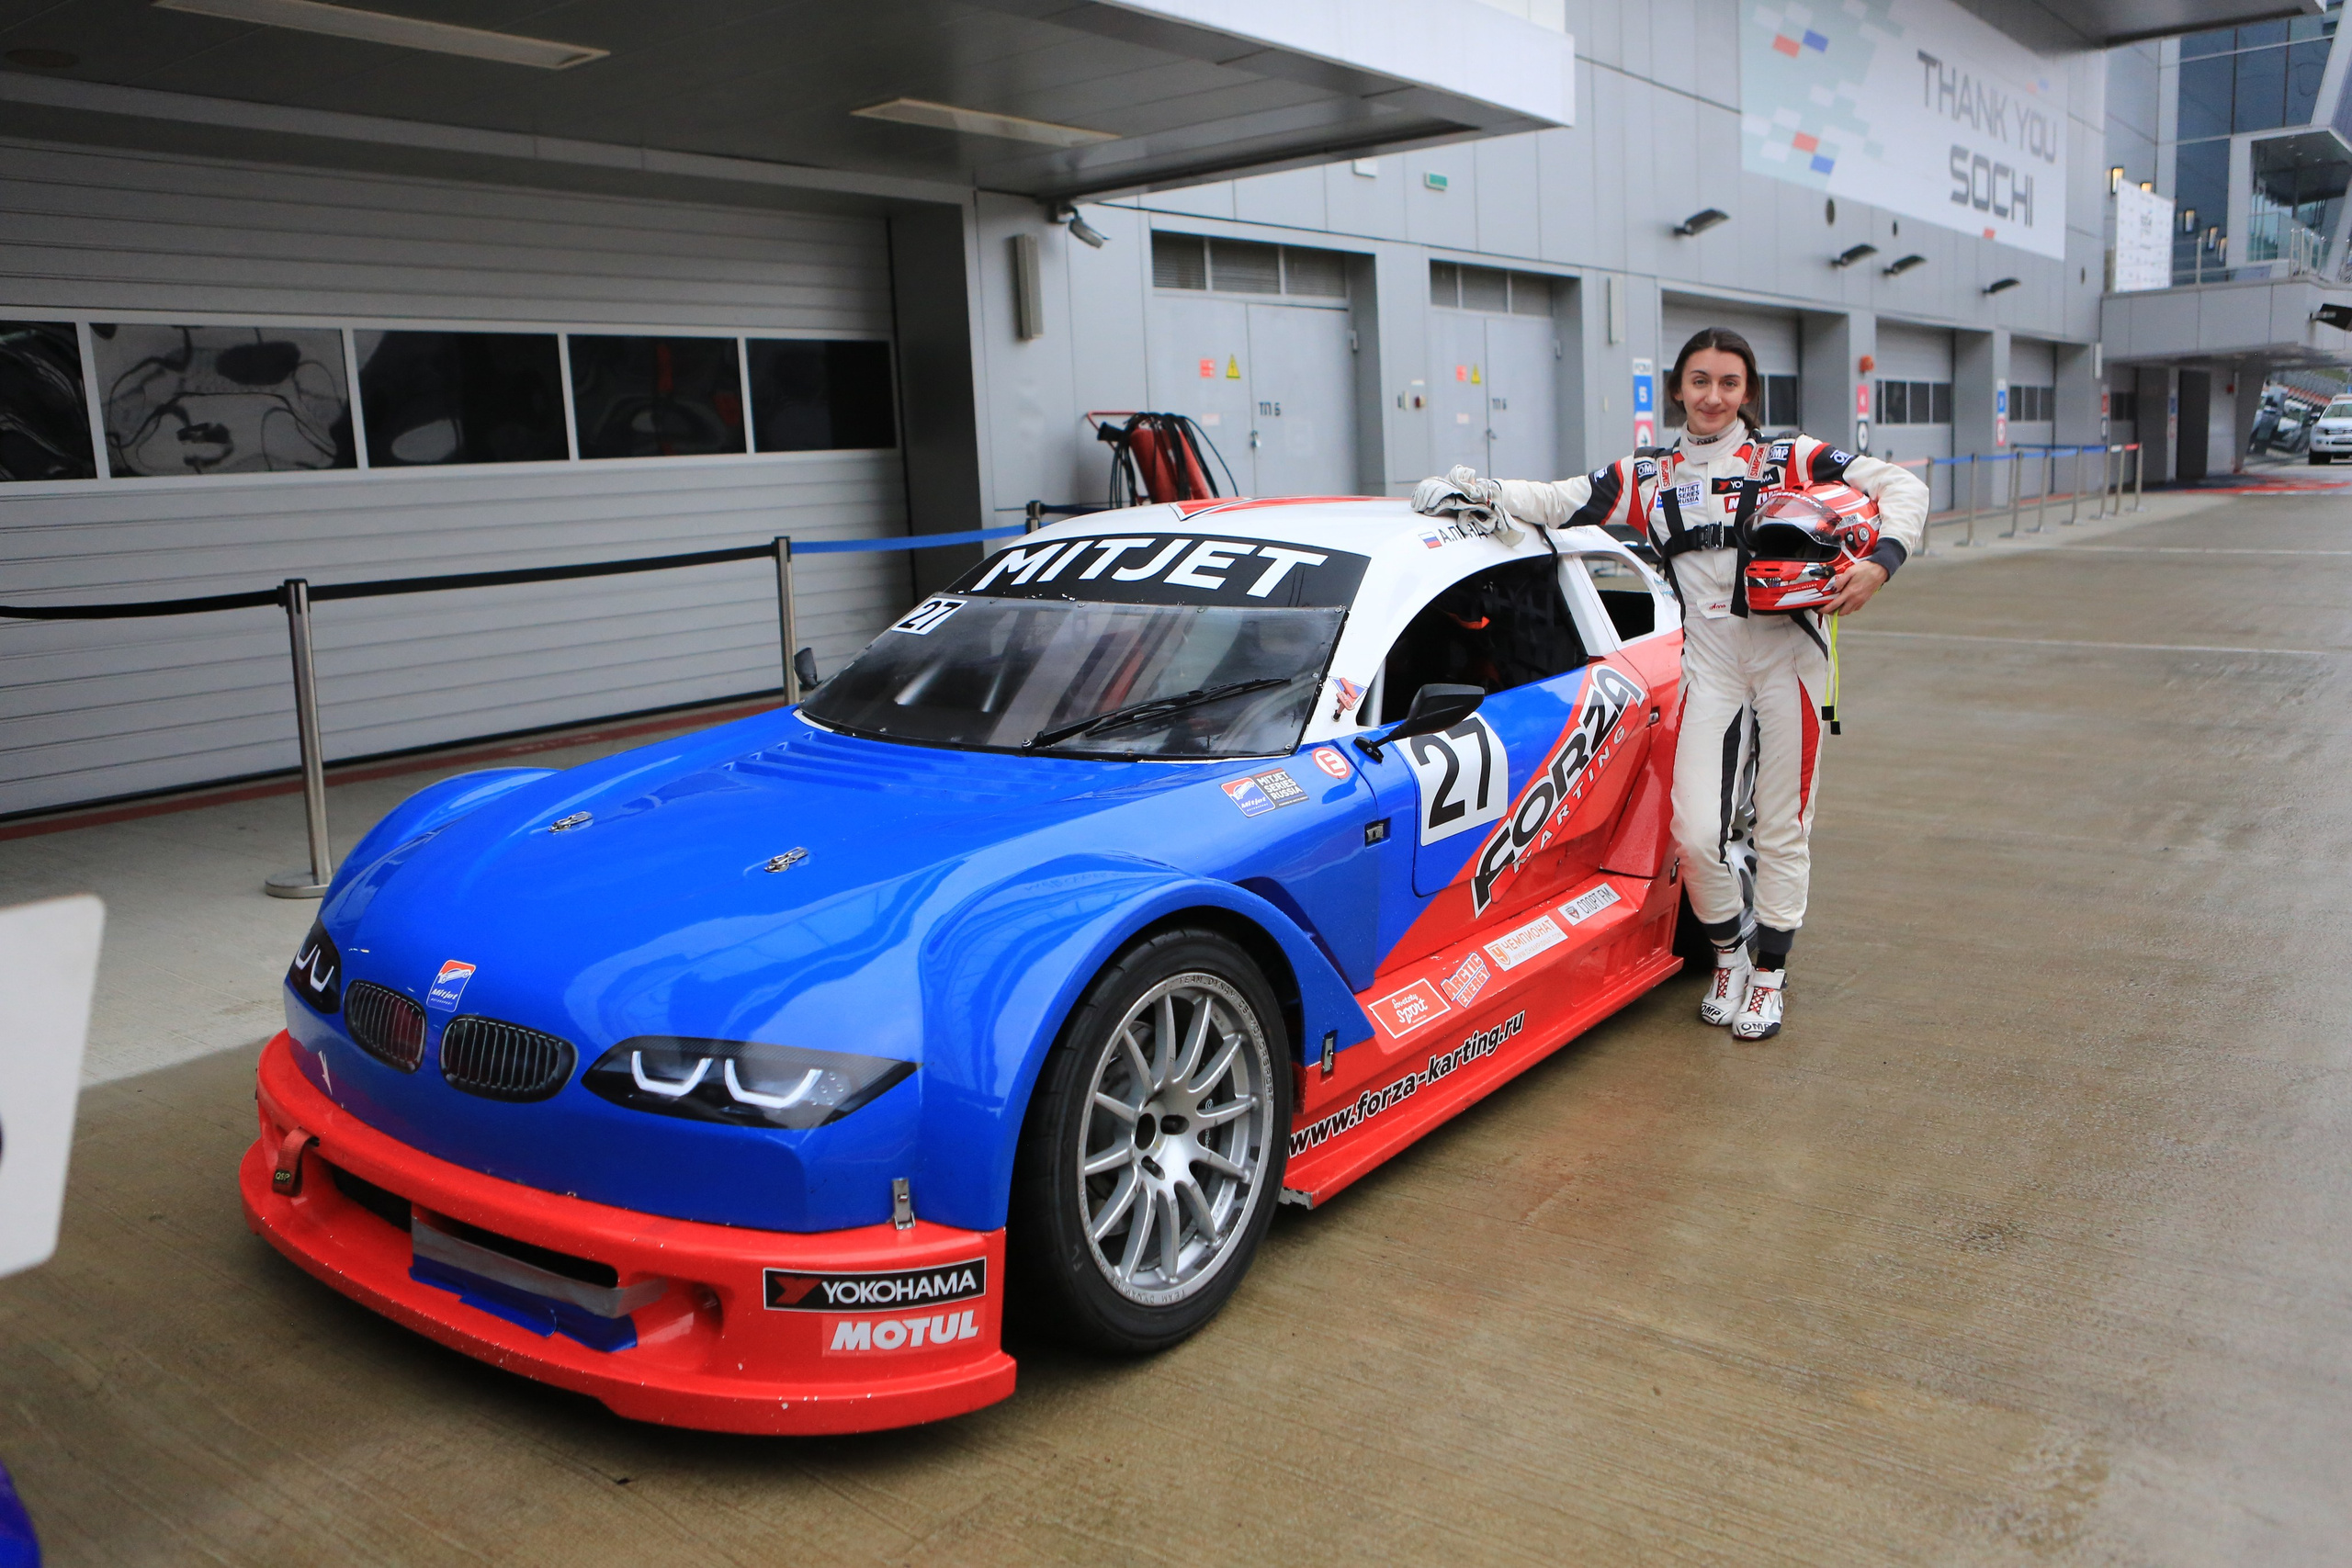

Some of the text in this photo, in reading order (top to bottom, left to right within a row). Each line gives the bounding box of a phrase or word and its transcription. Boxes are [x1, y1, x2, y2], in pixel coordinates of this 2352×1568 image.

[1917, 48, 2058, 164] THANK YOU
[1950, 143, 2033, 228] SOCHI
[1638, 386, 1648, 403] 5
[1750, 447, 1764, 476] SIMPSON
[1678, 497, 1700, 505] RUSSIA
[1679, 485, 1700, 493] MITJET
[1679, 491, 1700, 500] SERIES
[971, 538, 1329, 599] MITJET
[909, 602, 957, 631] 27
[1318, 752, 1345, 773] E
[1410, 716, 1491, 829] 27
[1256, 772, 1289, 786] MITJET
[1263, 779, 1296, 794] SERIES
[1271, 786, 1303, 800] RUSSIA
[1474, 665, 1644, 915] FORZA
[1240, 796, 1266, 808] Mitjet
[1514, 726, 1625, 873] KARTING
[1577, 887, 1614, 915] СПОРТ FM
[1502, 919, 1555, 952] ЧЕМПИОНАТ
[1441, 953, 1484, 1001] ARCTIC
[1457, 966, 1490, 1008] ENERGY
[431, 988, 458, 999] Mitjet
[1702, 1005, 1721, 1016] OMP
[1289, 1010, 1525, 1158] www.forza-karting.ru
[821, 1269, 977, 1303] YOKOHAMA
[831, 1309, 978, 1350] MOTUL
